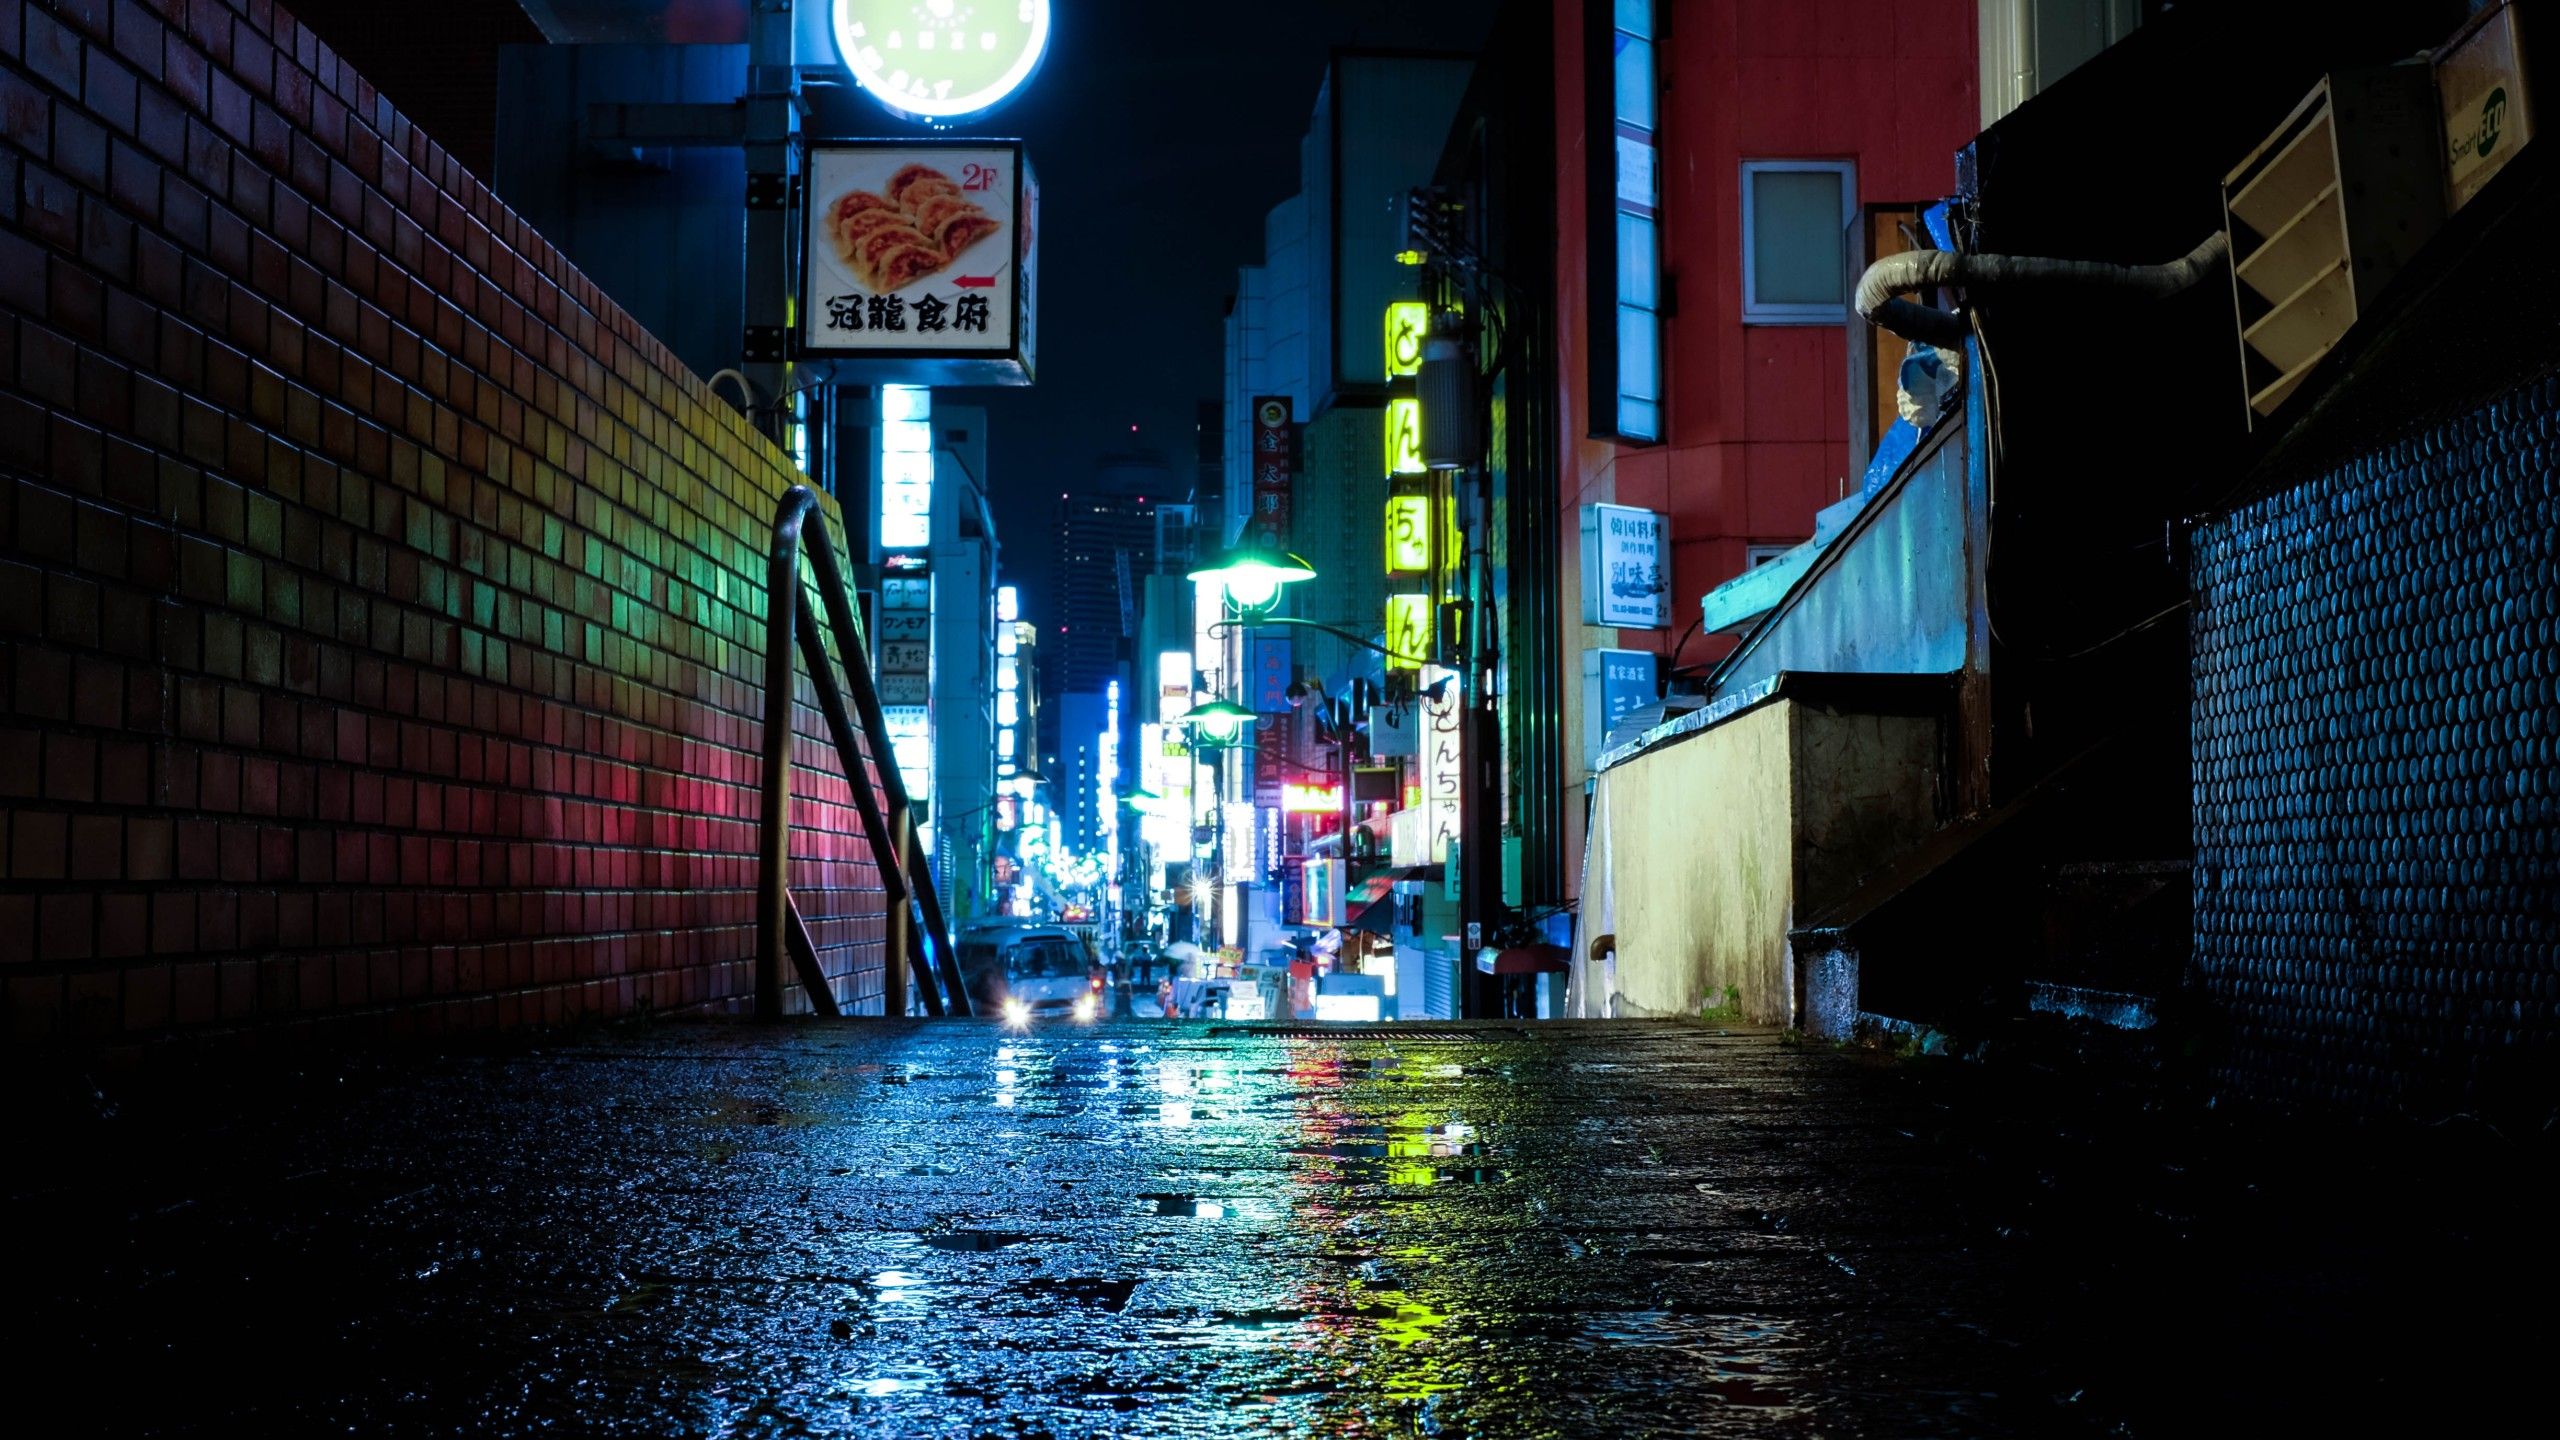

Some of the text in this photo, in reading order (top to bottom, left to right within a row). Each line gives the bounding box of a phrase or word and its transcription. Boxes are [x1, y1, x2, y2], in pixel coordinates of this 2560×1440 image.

[962, 163, 998, 192] 2F
[825, 292, 991, 333] 冠龍食府
[1610, 516, 1663, 541] 韓国料理
